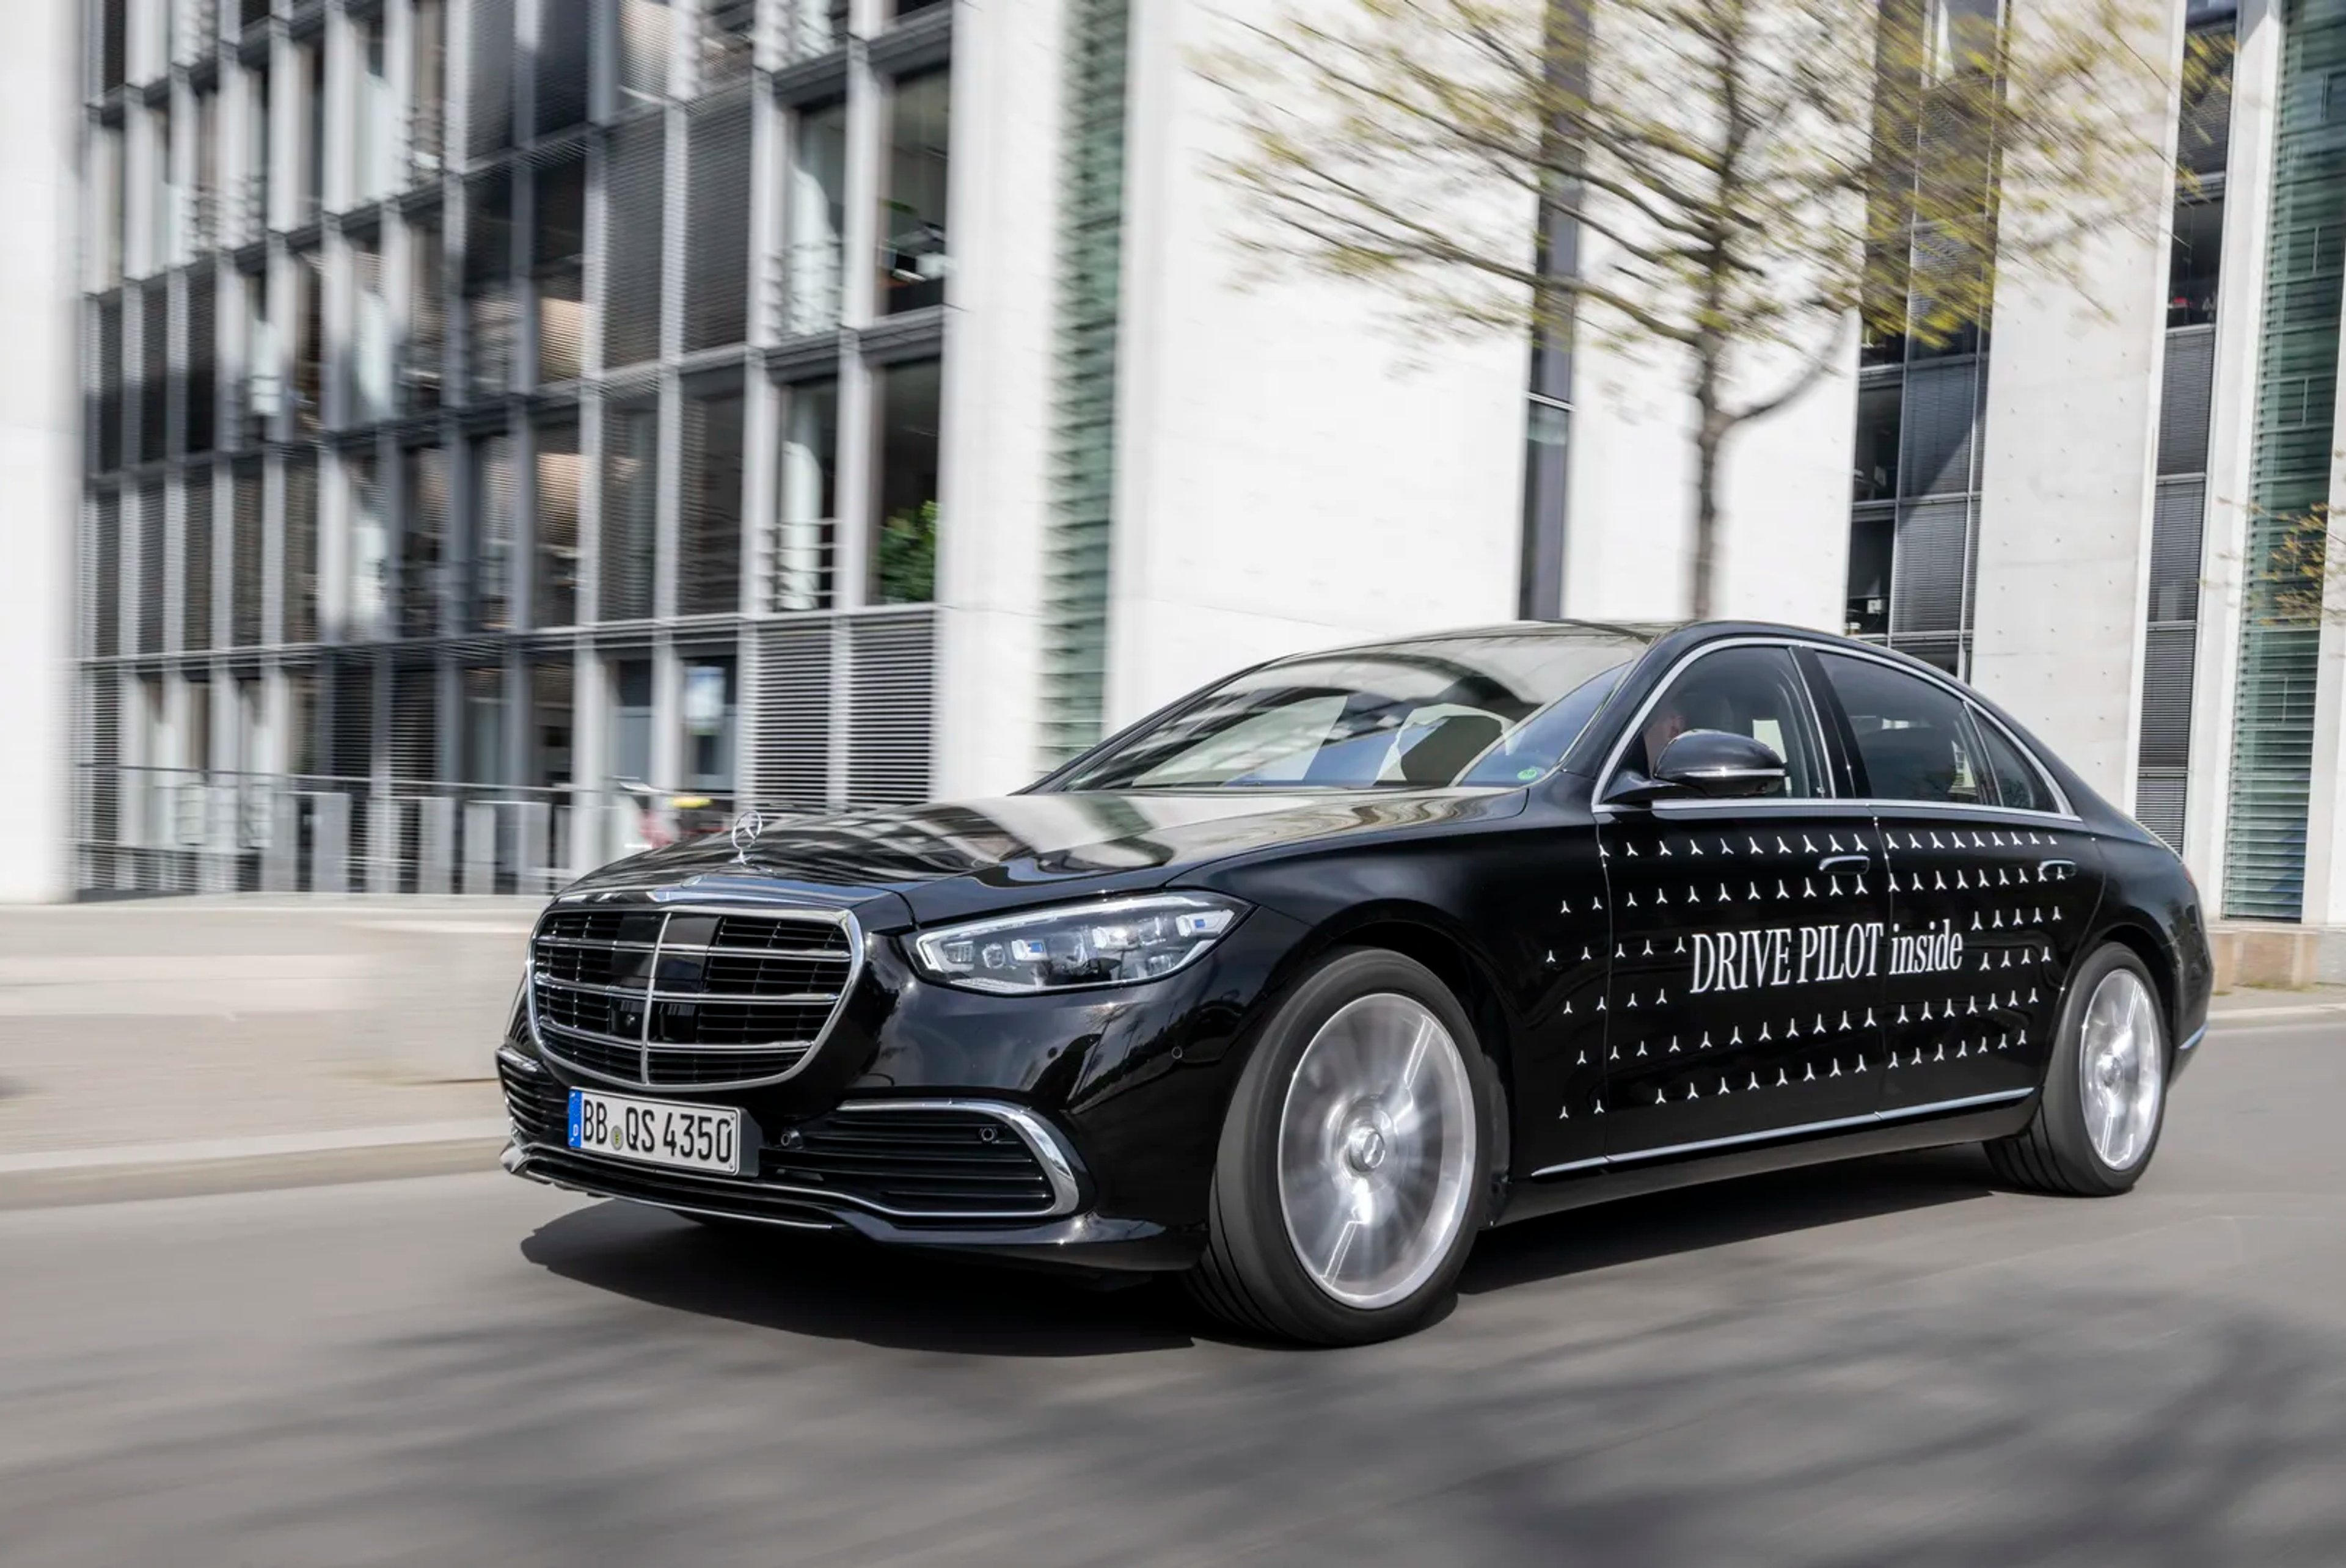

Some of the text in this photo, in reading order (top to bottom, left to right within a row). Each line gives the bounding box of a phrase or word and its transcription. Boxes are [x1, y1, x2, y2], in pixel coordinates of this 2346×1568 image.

[1689, 919, 1964, 993] DRIVE PILOT inside
[583, 1099, 733, 1163] BB QS 4350
